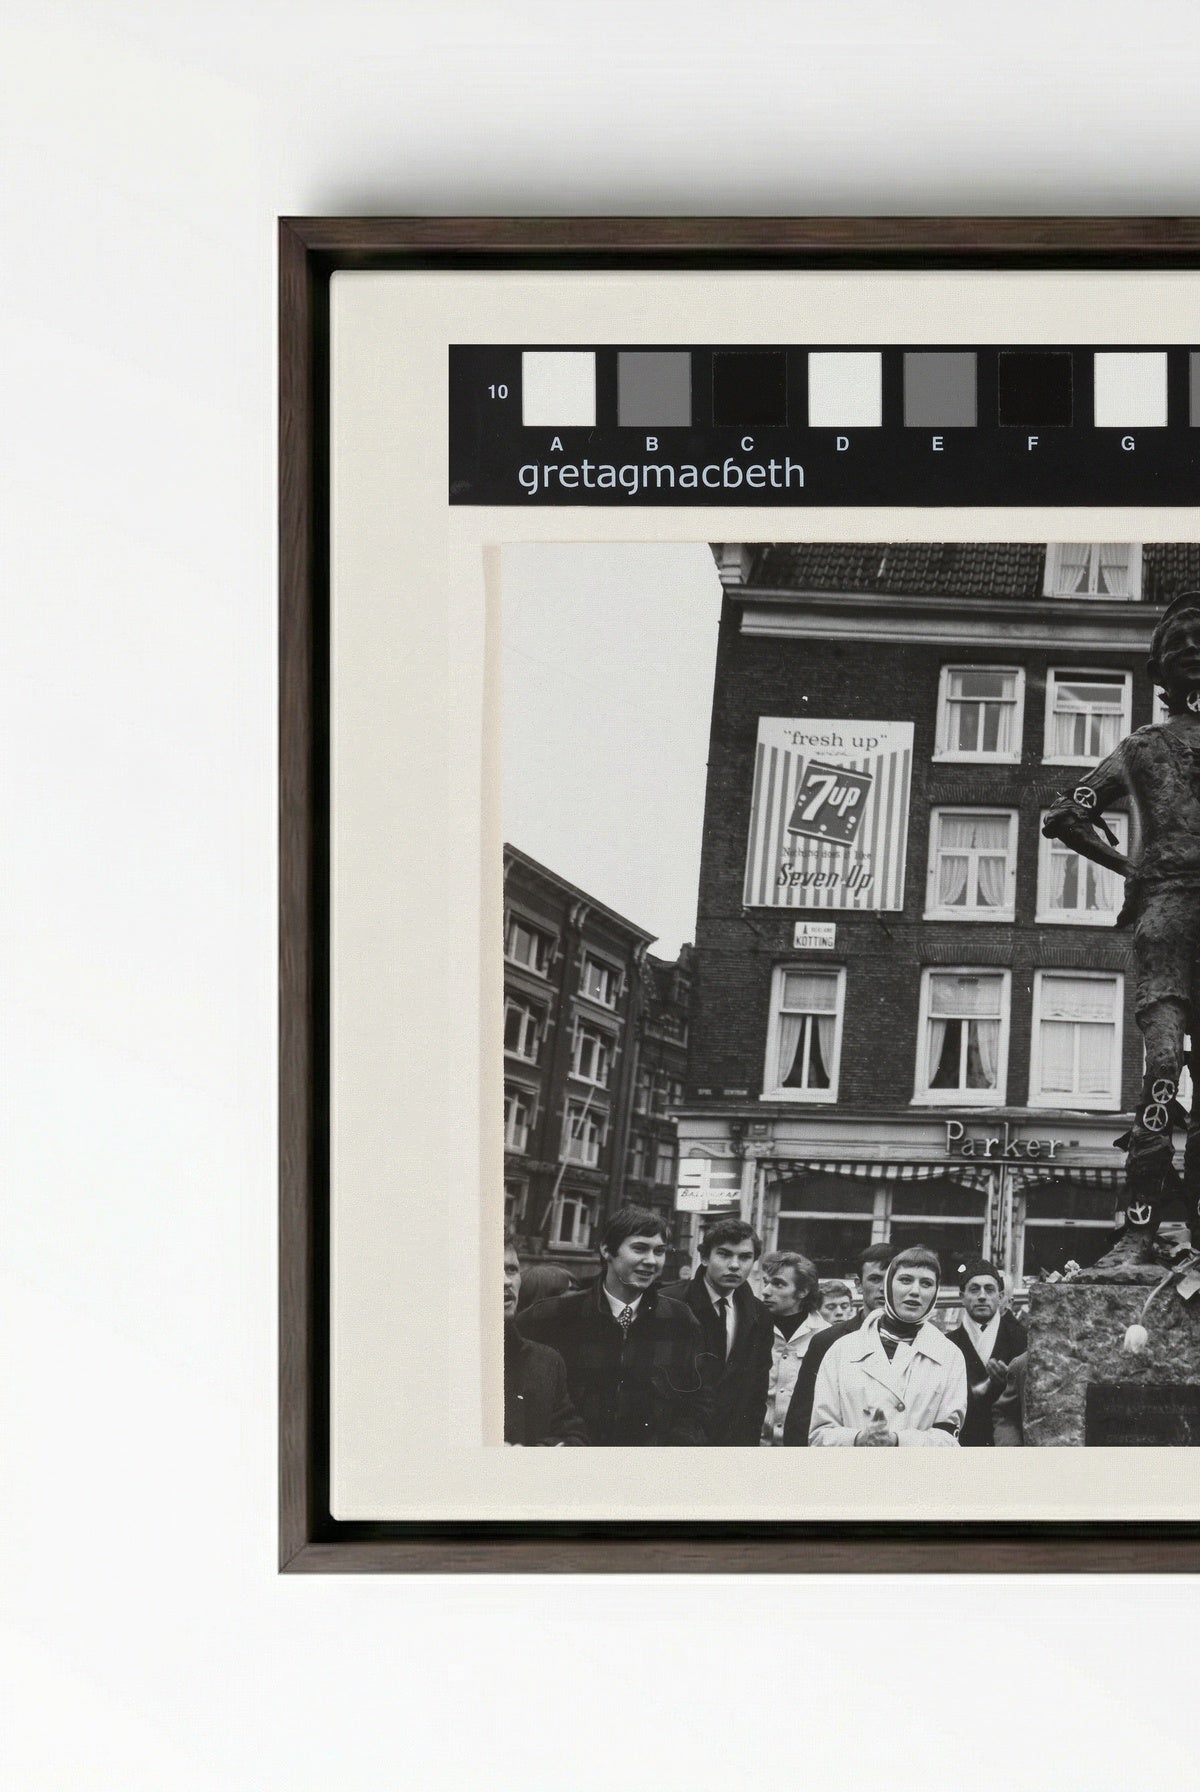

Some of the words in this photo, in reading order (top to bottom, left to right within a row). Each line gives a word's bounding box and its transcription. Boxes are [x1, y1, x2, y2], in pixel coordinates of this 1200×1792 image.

[487, 384, 509, 400] 10
[550, 436, 564, 452] A
[646, 436, 659, 452] B
[740, 436, 754, 452] C
[836, 436, 850, 451] D
[932, 436, 944, 451] E
[1027, 436, 1039, 451] F
[1121, 435, 1135, 451] G
[518, 456, 805, 496] gretagmacbeth
[944, 1120, 1064, 1158] Parker
